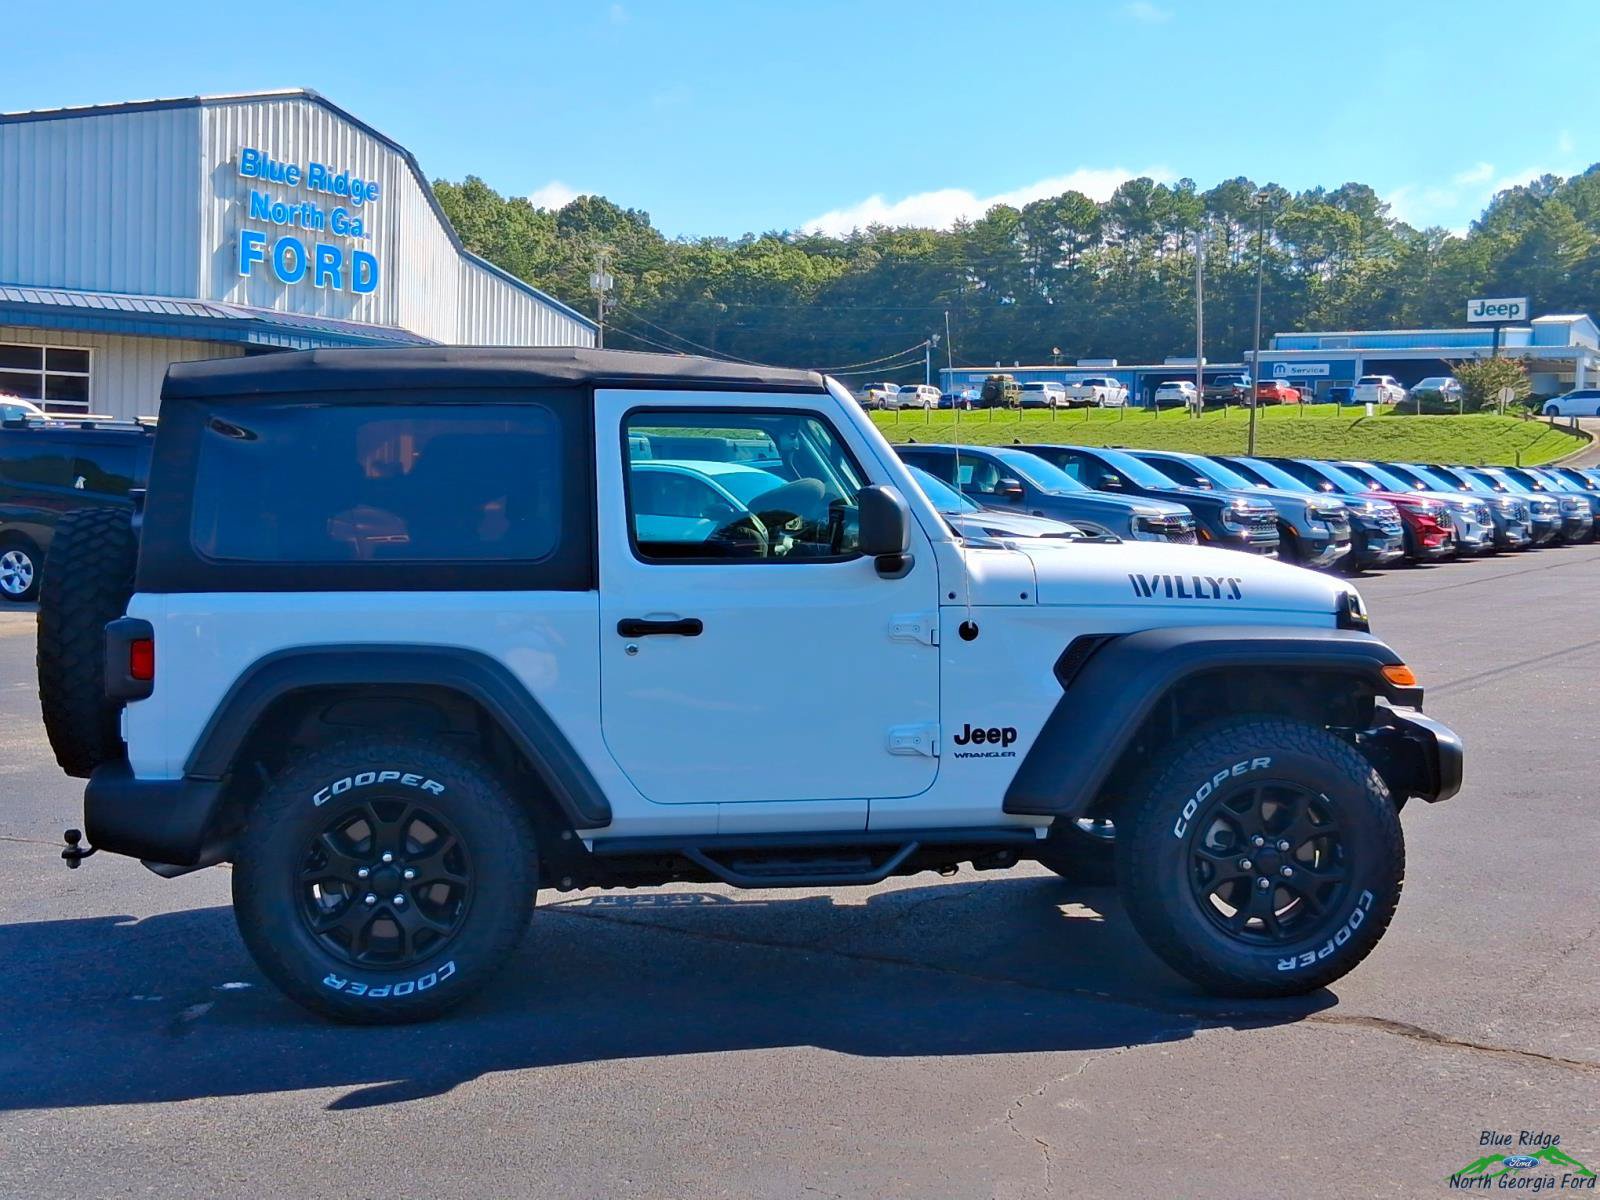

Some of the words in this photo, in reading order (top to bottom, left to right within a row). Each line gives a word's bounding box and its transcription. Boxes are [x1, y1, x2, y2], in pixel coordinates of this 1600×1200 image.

[240, 148, 300, 187] Blue
[307, 161, 380, 206] Ridge
[249, 189, 325, 232] North
[239, 228, 379, 295] FORD
[1473, 301, 1520, 319] Jeep
[1291, 366, 1325, 375] Service
[1127, 573, 1242, 600] WILLYS
[953, 723, 1018, 748] Jeep
[953, 751, 1016, 759] WRANGLER
[313, 770, 445, 807] COOPER
[1174, 756, 1271, 839] COOPER
[1277, 889, 1373, 971] COOPER
[323, 960, 456, 997] COOPER
